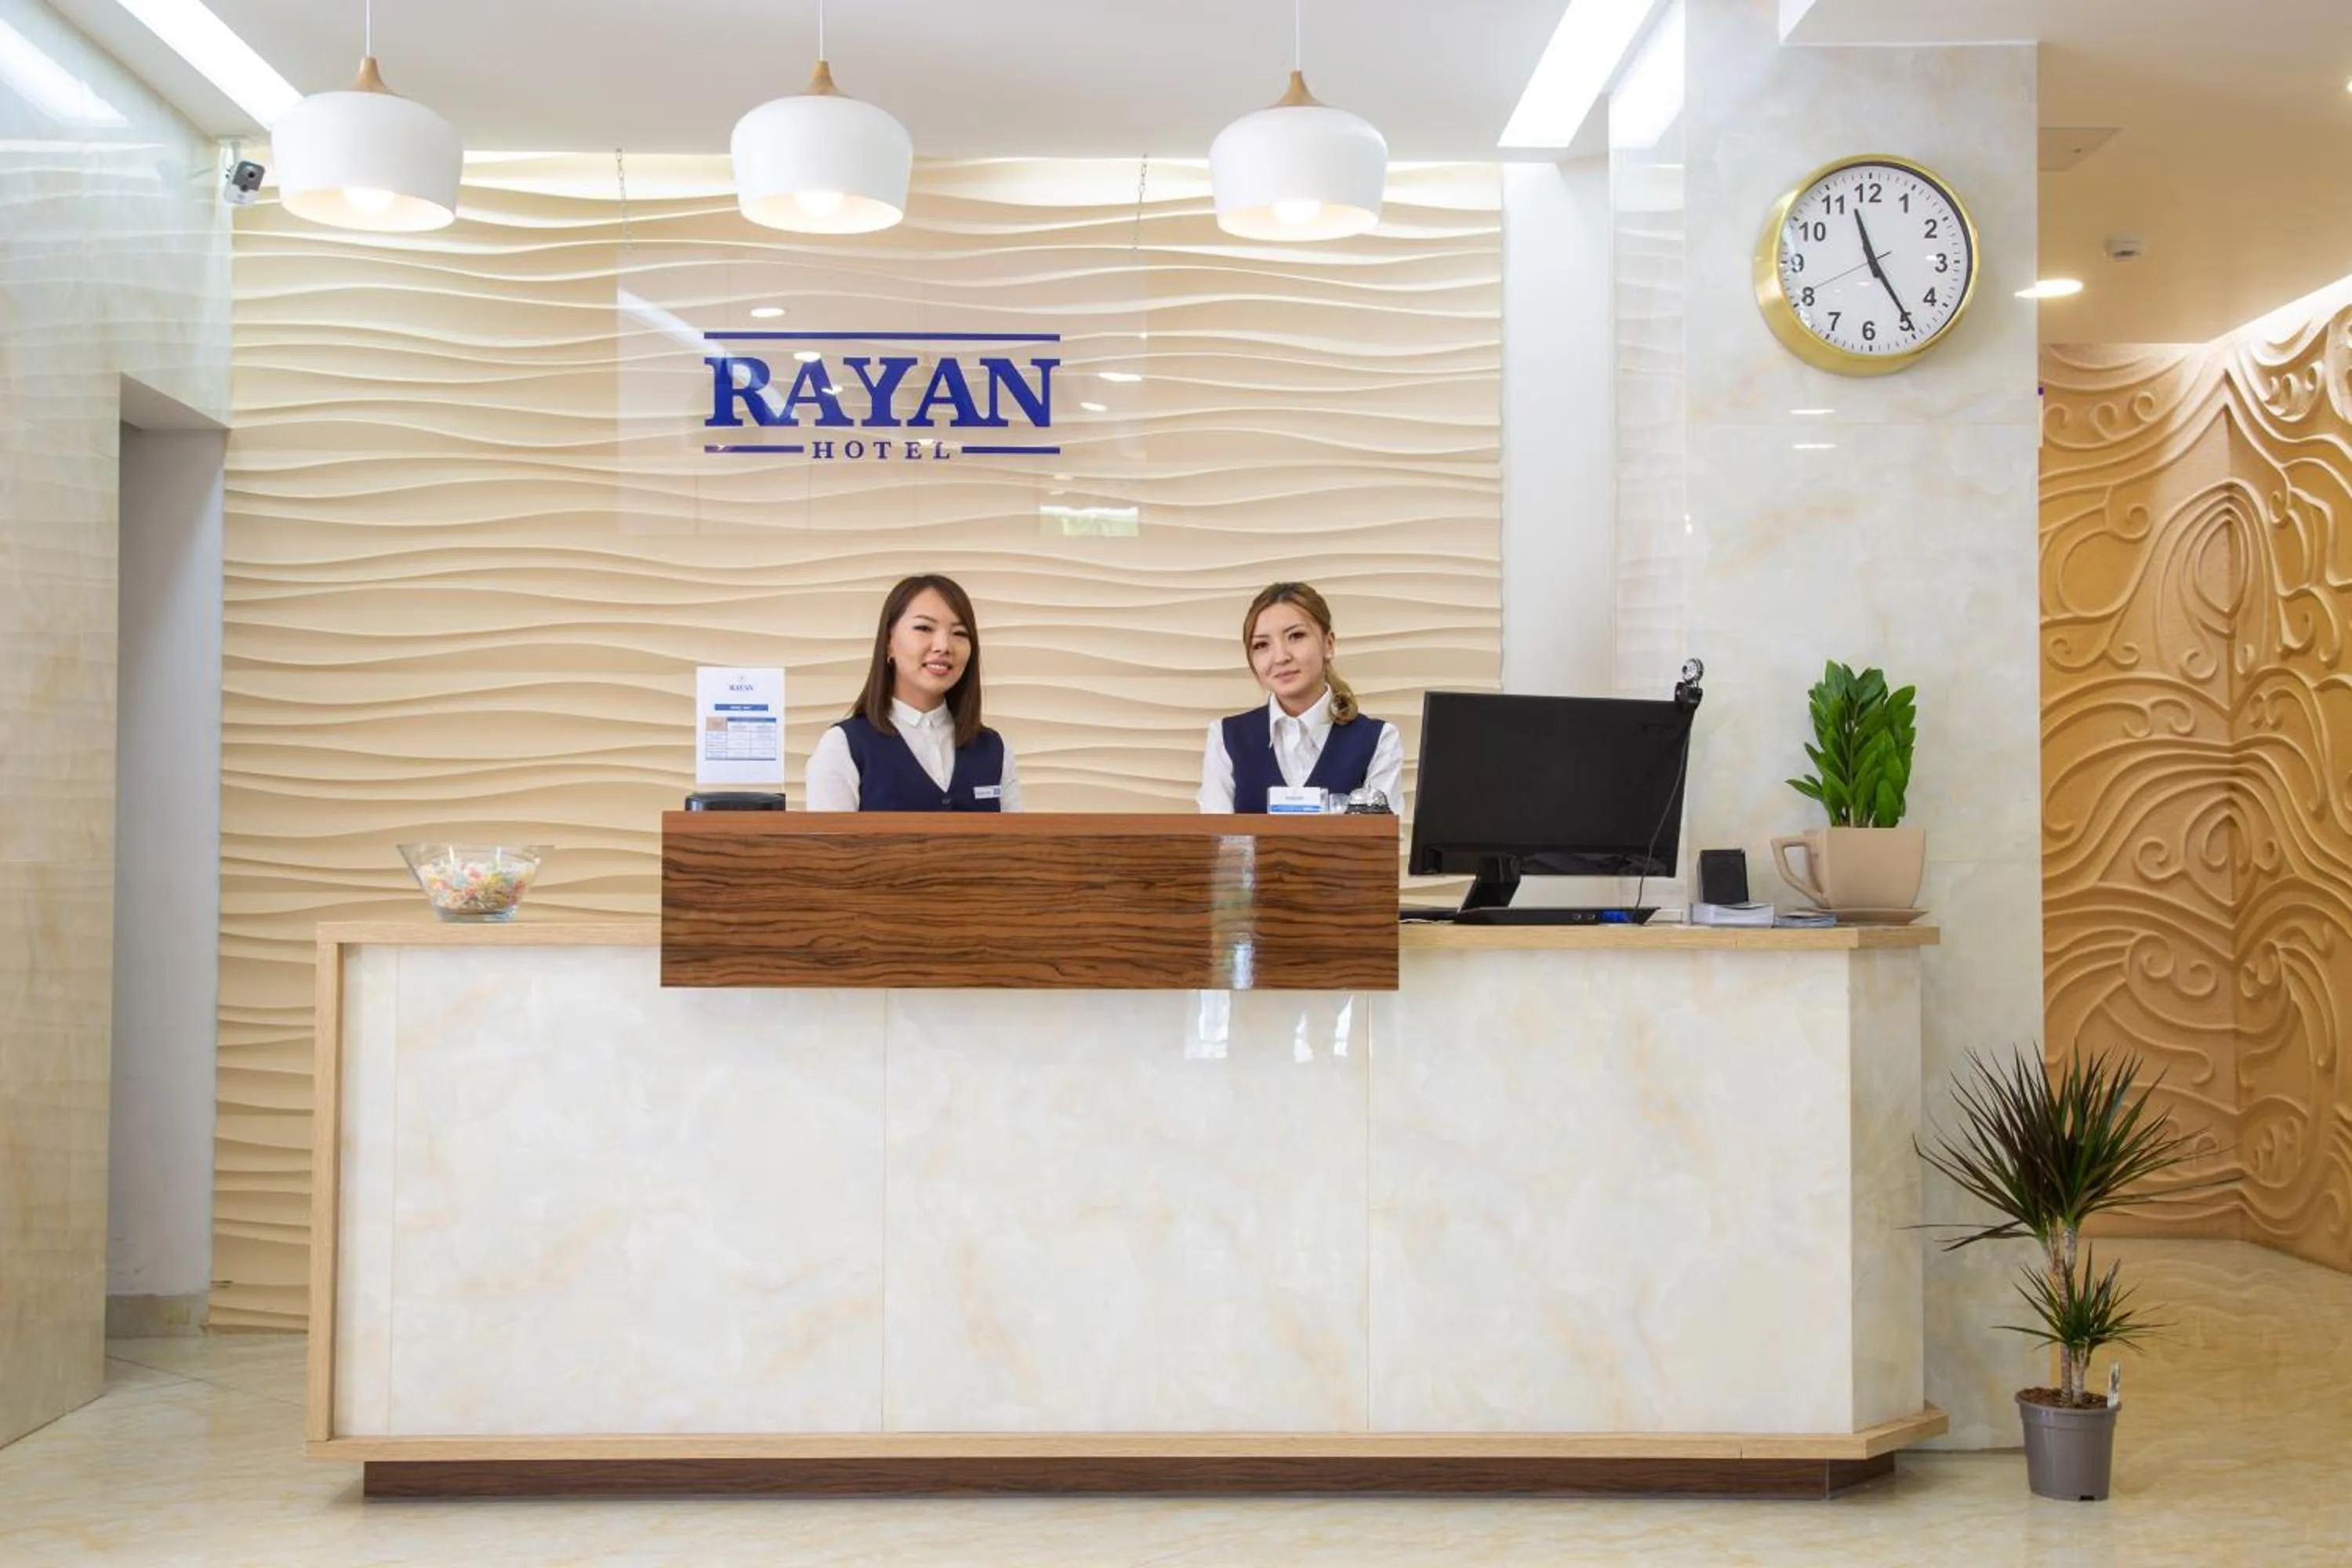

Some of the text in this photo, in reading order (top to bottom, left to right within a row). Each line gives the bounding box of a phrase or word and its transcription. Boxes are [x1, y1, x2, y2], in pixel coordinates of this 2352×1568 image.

[1854, 183, 1882, 203] 12
[1899, 193, 1909, 213] 1
[1821, 194, 1845, 215] 11
[1798, 221, 1825, 241] 10
[1924, 219, 1937, 239] 2
[1791, 253, 1804, 273] 9
[1934, 252, 1948, 273] 3
[1802, 286, 1815, 307] 8
[1923, 286, 1937, 307] 4
[1828, 311, 1842, 332] 7
[1862, 321, 1876, 341] 6
[1899, 311, 1913, 332] 5
[704, 357, 1060, 427] RAYAN
[812, 441, 950, 459] HOTEL
